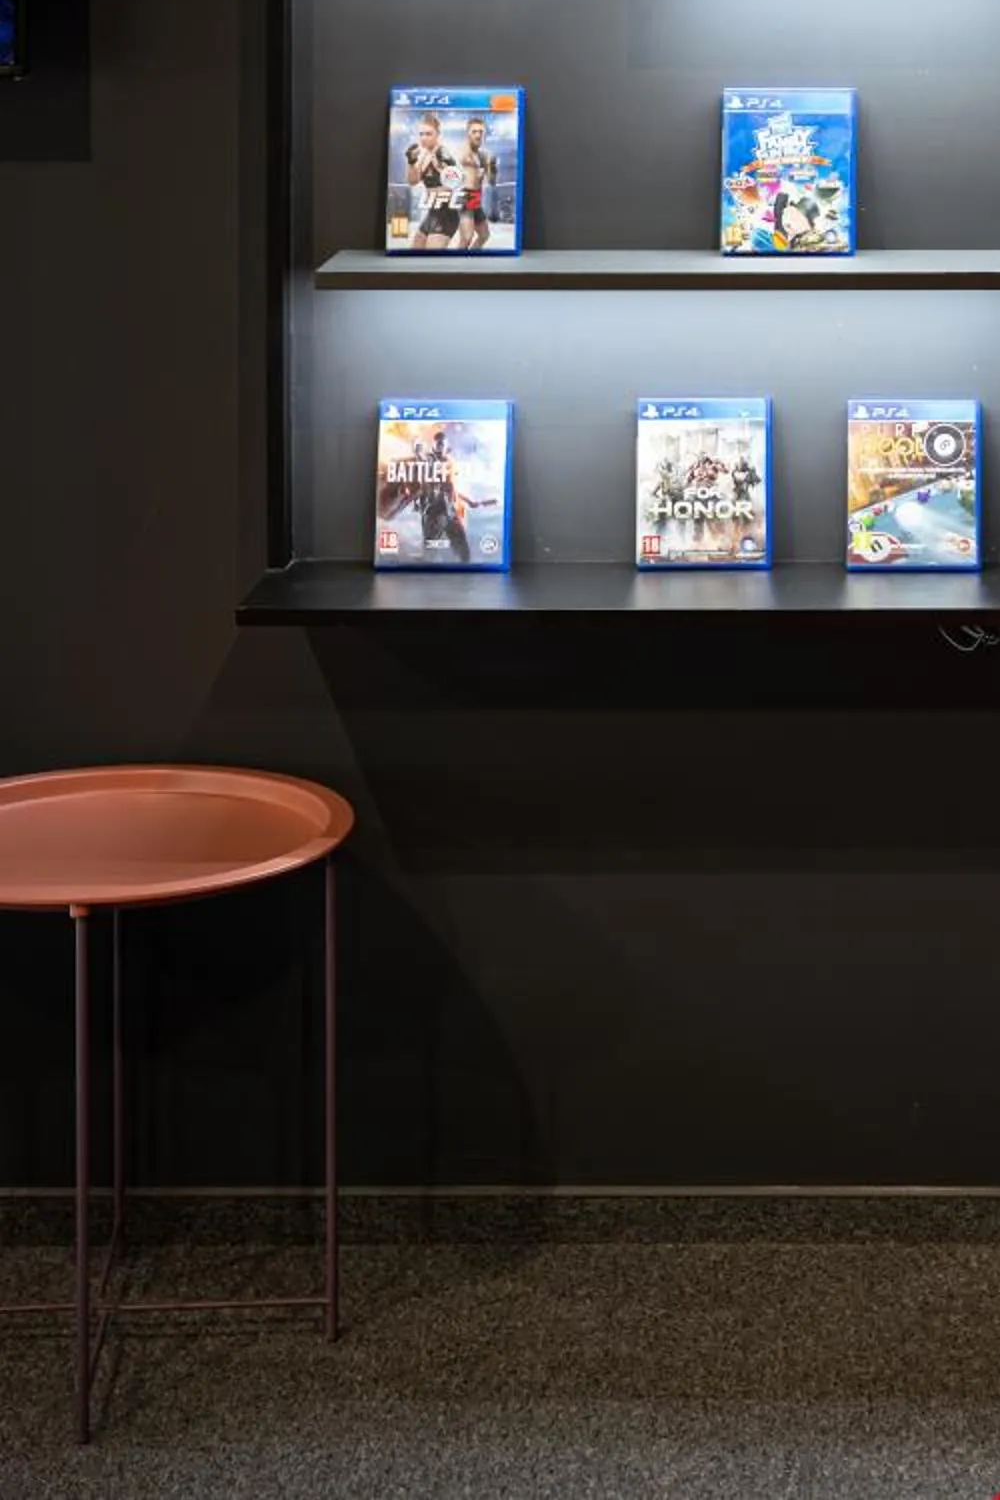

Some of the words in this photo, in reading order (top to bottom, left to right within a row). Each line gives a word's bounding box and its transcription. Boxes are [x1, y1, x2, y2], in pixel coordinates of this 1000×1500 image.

[414, 95, 450, 105] PS4
[745, 98, 783, 108] PS4
[417, 190, 466, 210] UFC
[403, 407, 440, 418] PS4
[662, 406, 700, 417] PS4
[871, 407, 910, 418] PS4
[683, 487, 721, 500] FOR
[649, 501, 754, 520] HONOR
